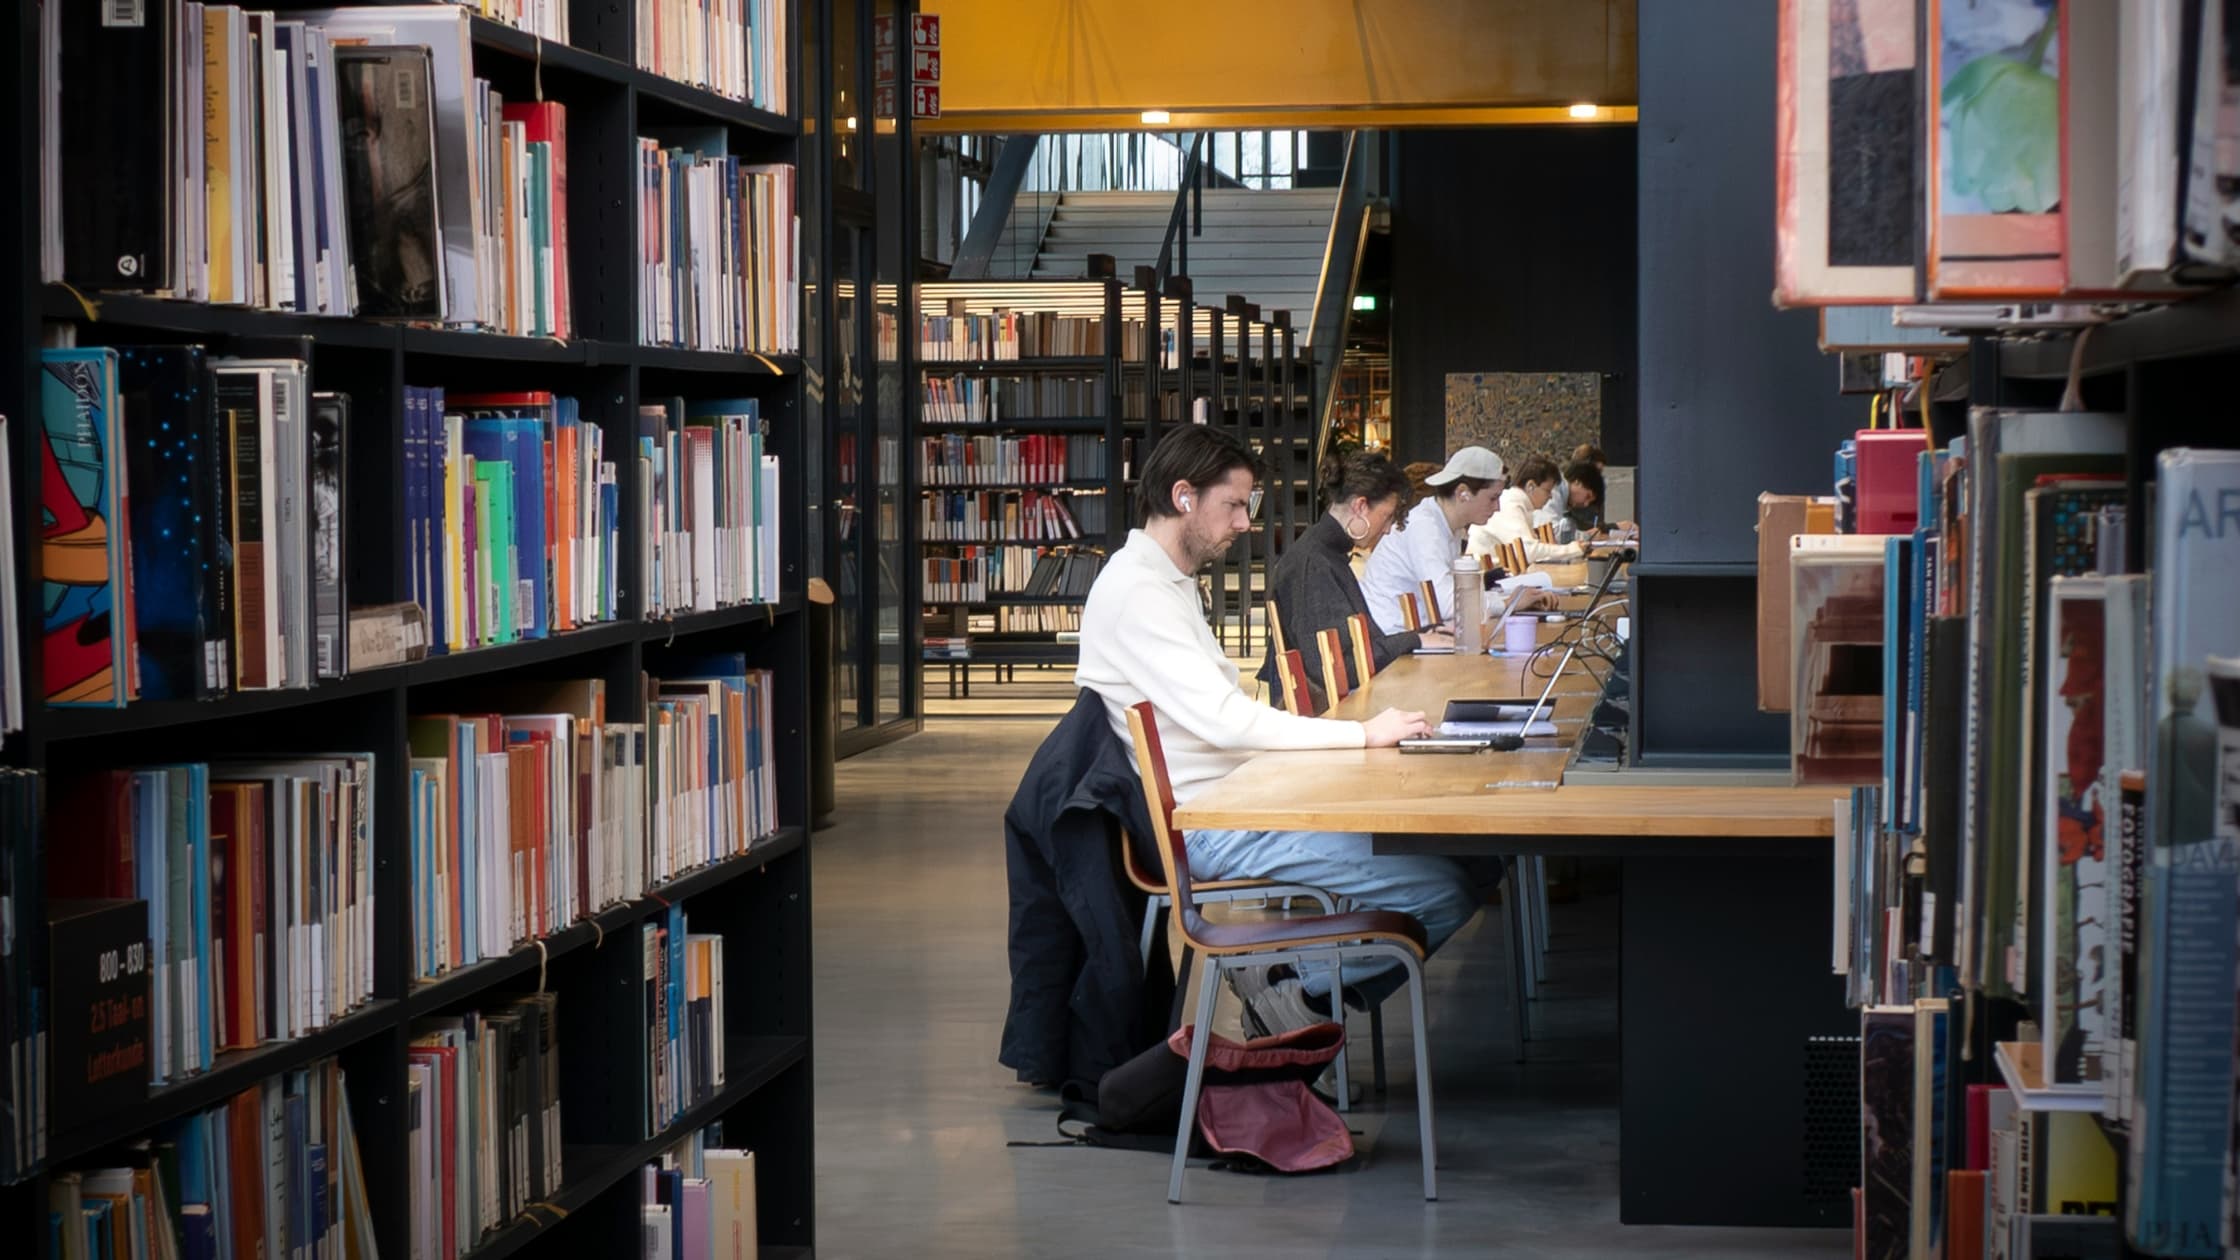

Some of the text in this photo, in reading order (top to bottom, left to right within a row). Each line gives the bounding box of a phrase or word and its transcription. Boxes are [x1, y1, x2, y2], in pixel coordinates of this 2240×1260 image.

[75, 360, 92, 448] PHAIDON
[2121, 803, 2135, 954] FOTOGRAFIE
[99, 950, 118, 983] 800
[127, 942, 144, 975] 830
